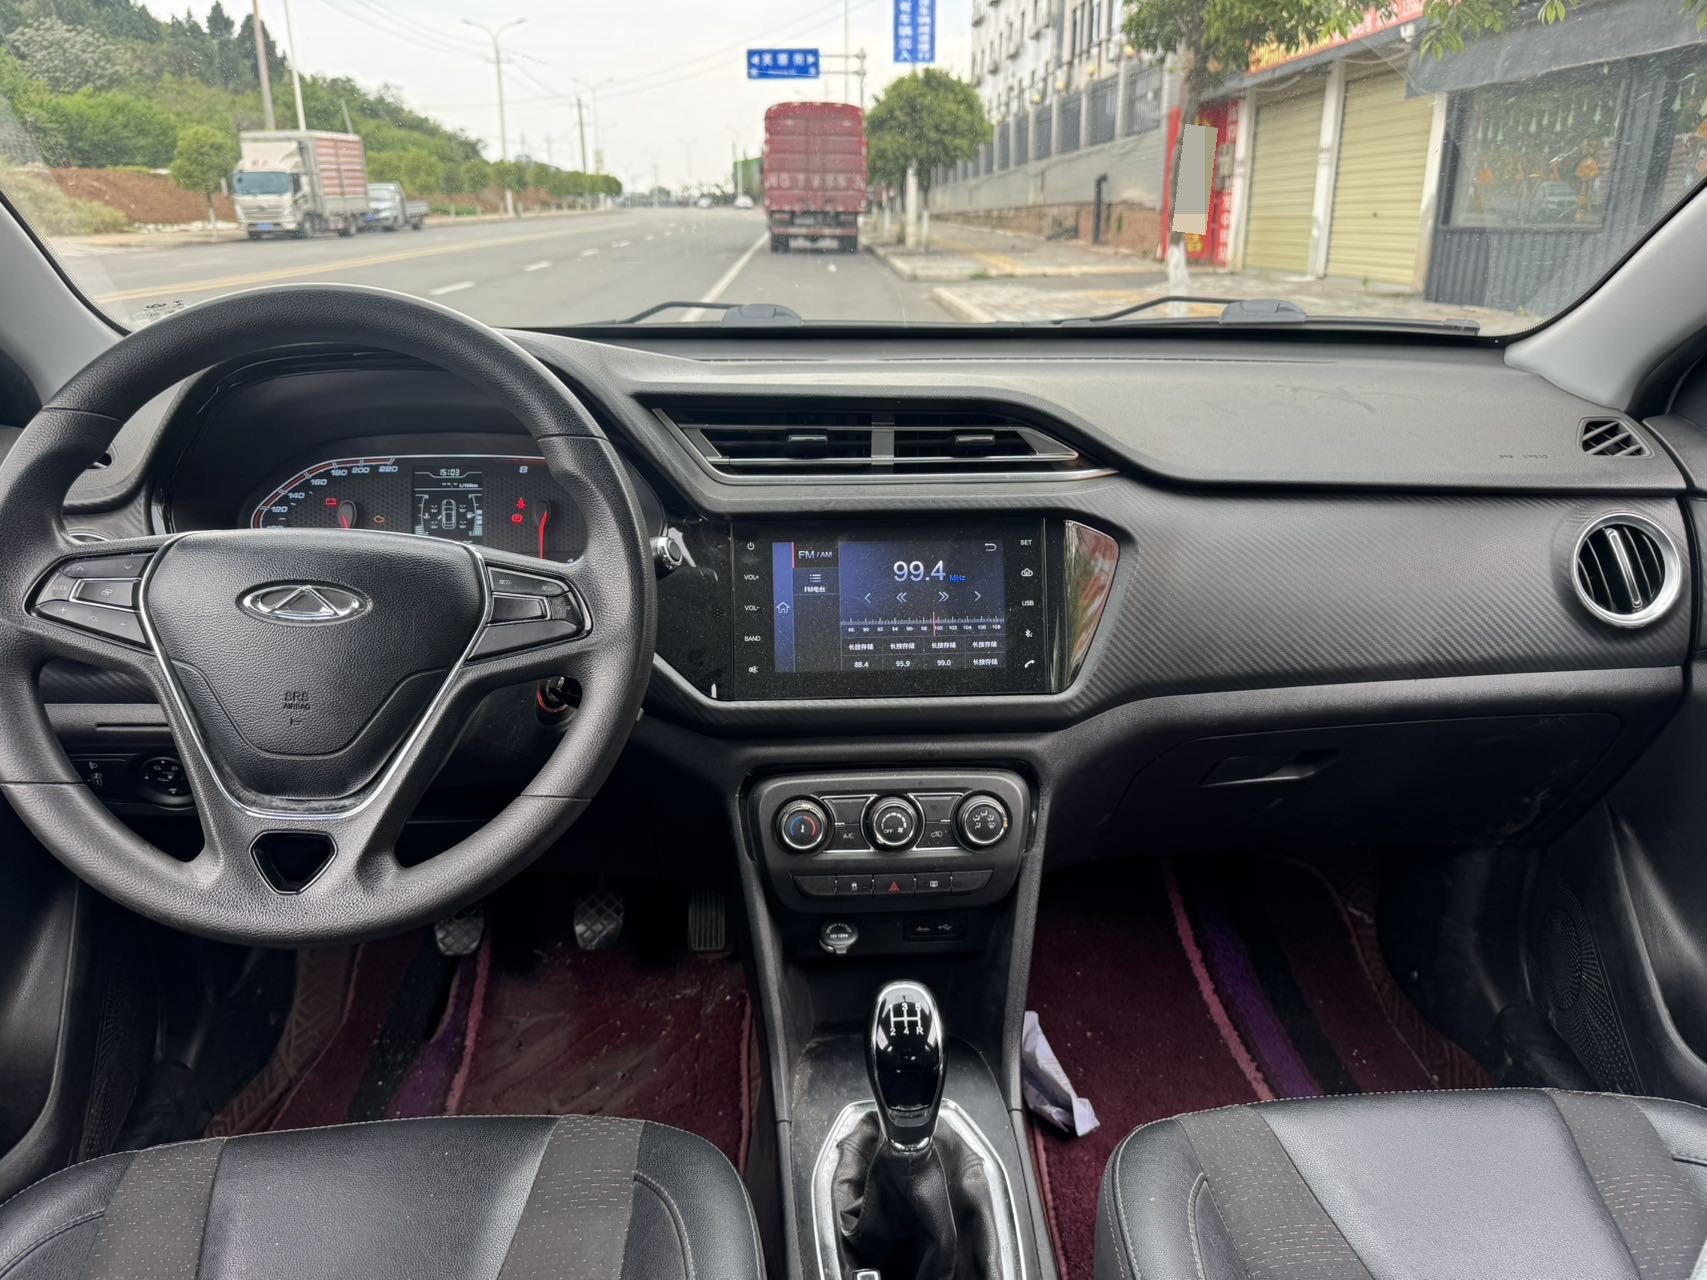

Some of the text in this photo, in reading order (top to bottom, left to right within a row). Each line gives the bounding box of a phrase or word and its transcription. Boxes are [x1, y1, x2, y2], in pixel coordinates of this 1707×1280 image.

[351, 466, 370, 474] 200
[378, 465, 399, 473] 220
[440, 468, 461, 476] 15:03
[287, 491, 306, 499] 140
[270, 505, 289, 513] 120
[893, 560, 966, 582] 99.4 MHz
[1021, 599, 1035, 607] USB
[895, 660, 911, 668] 95.9
[936, 659, 952, 667] 99.0
[901, 1002, 909, 1011] 3
[915, 1002, 922, 1011] 5
[890, 1026, 924, 1036] 2 4 R
